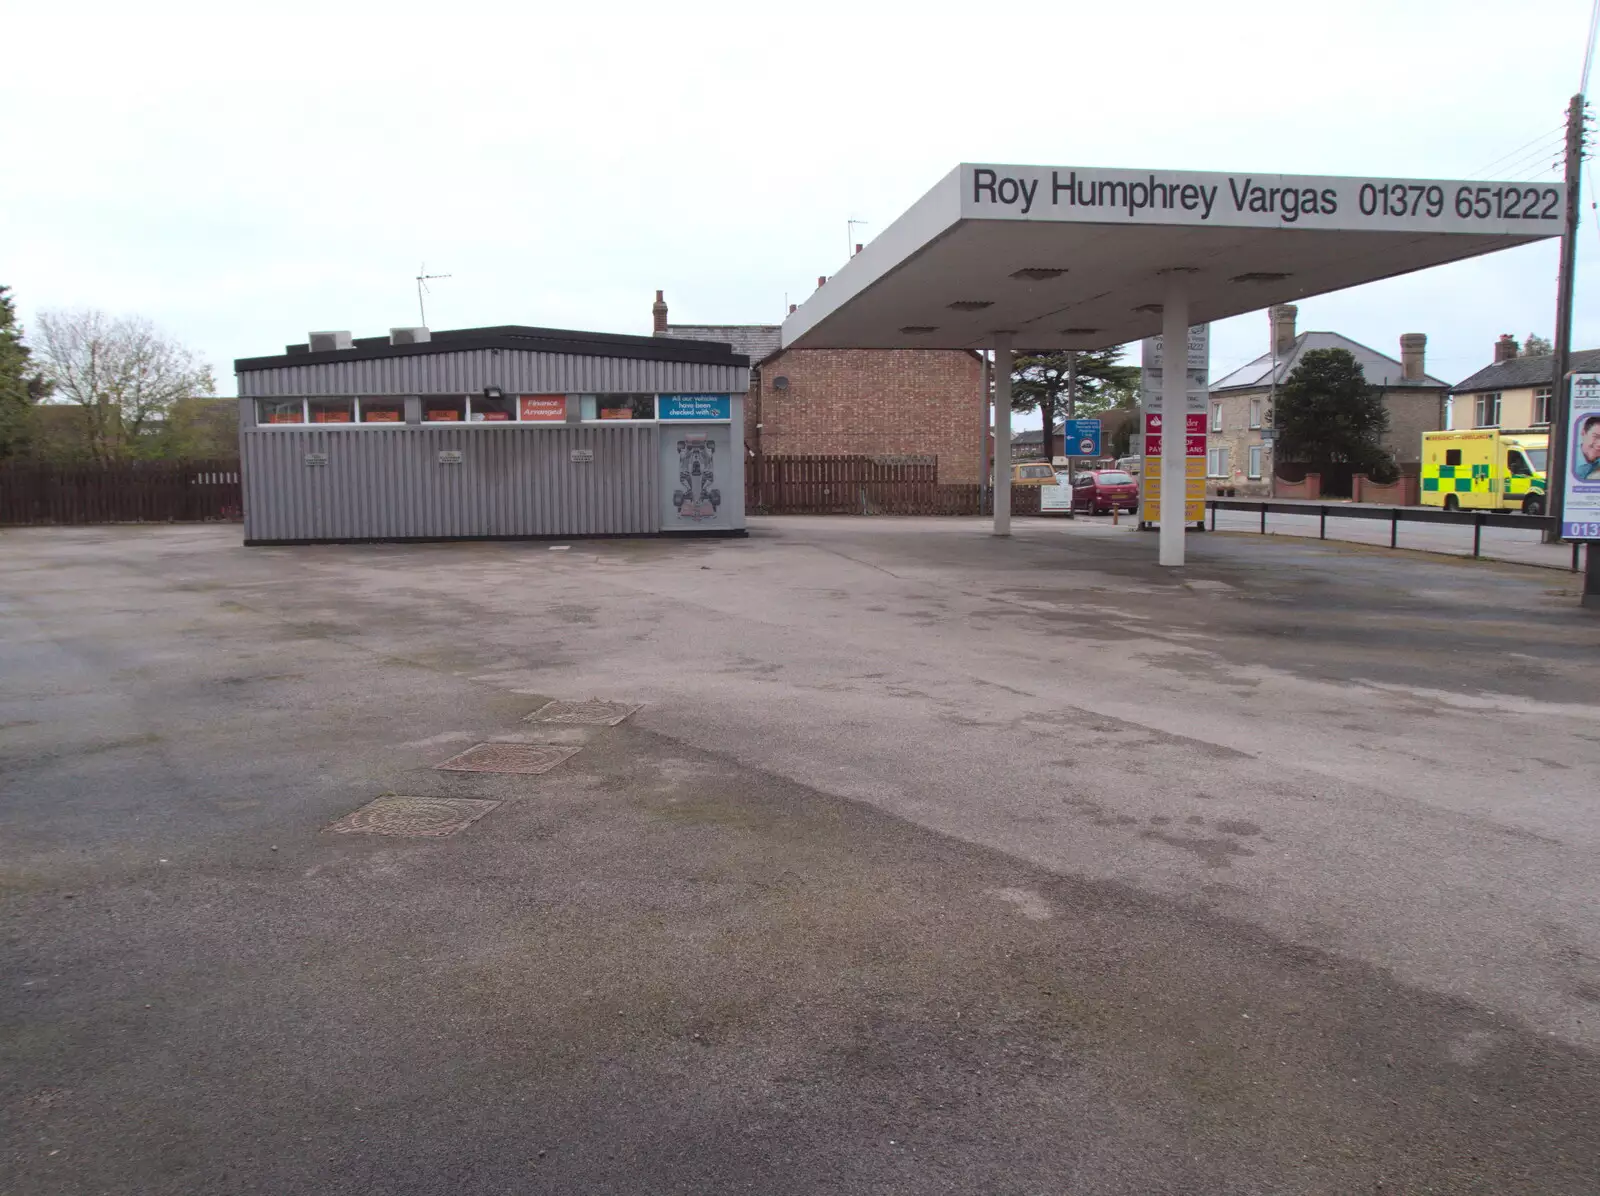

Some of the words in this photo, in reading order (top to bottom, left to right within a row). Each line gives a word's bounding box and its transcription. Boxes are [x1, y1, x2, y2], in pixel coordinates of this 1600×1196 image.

[973, 168, 1039, 214] Roy
[1051, 171, 1218, 220] Humphrey
[1228, 177, 1337, 222] Vargas
[1359, 183, 1444, 218] 01379
[1455, 186, 1559, 220] 651222
[527, 399, 558, 407] Finance
[524, 408, 562, 416] Arranged
[669, 408, 695, 416] checked
[695, 408, 710, 416] with
[1571, 522, 1600, 537] 013
